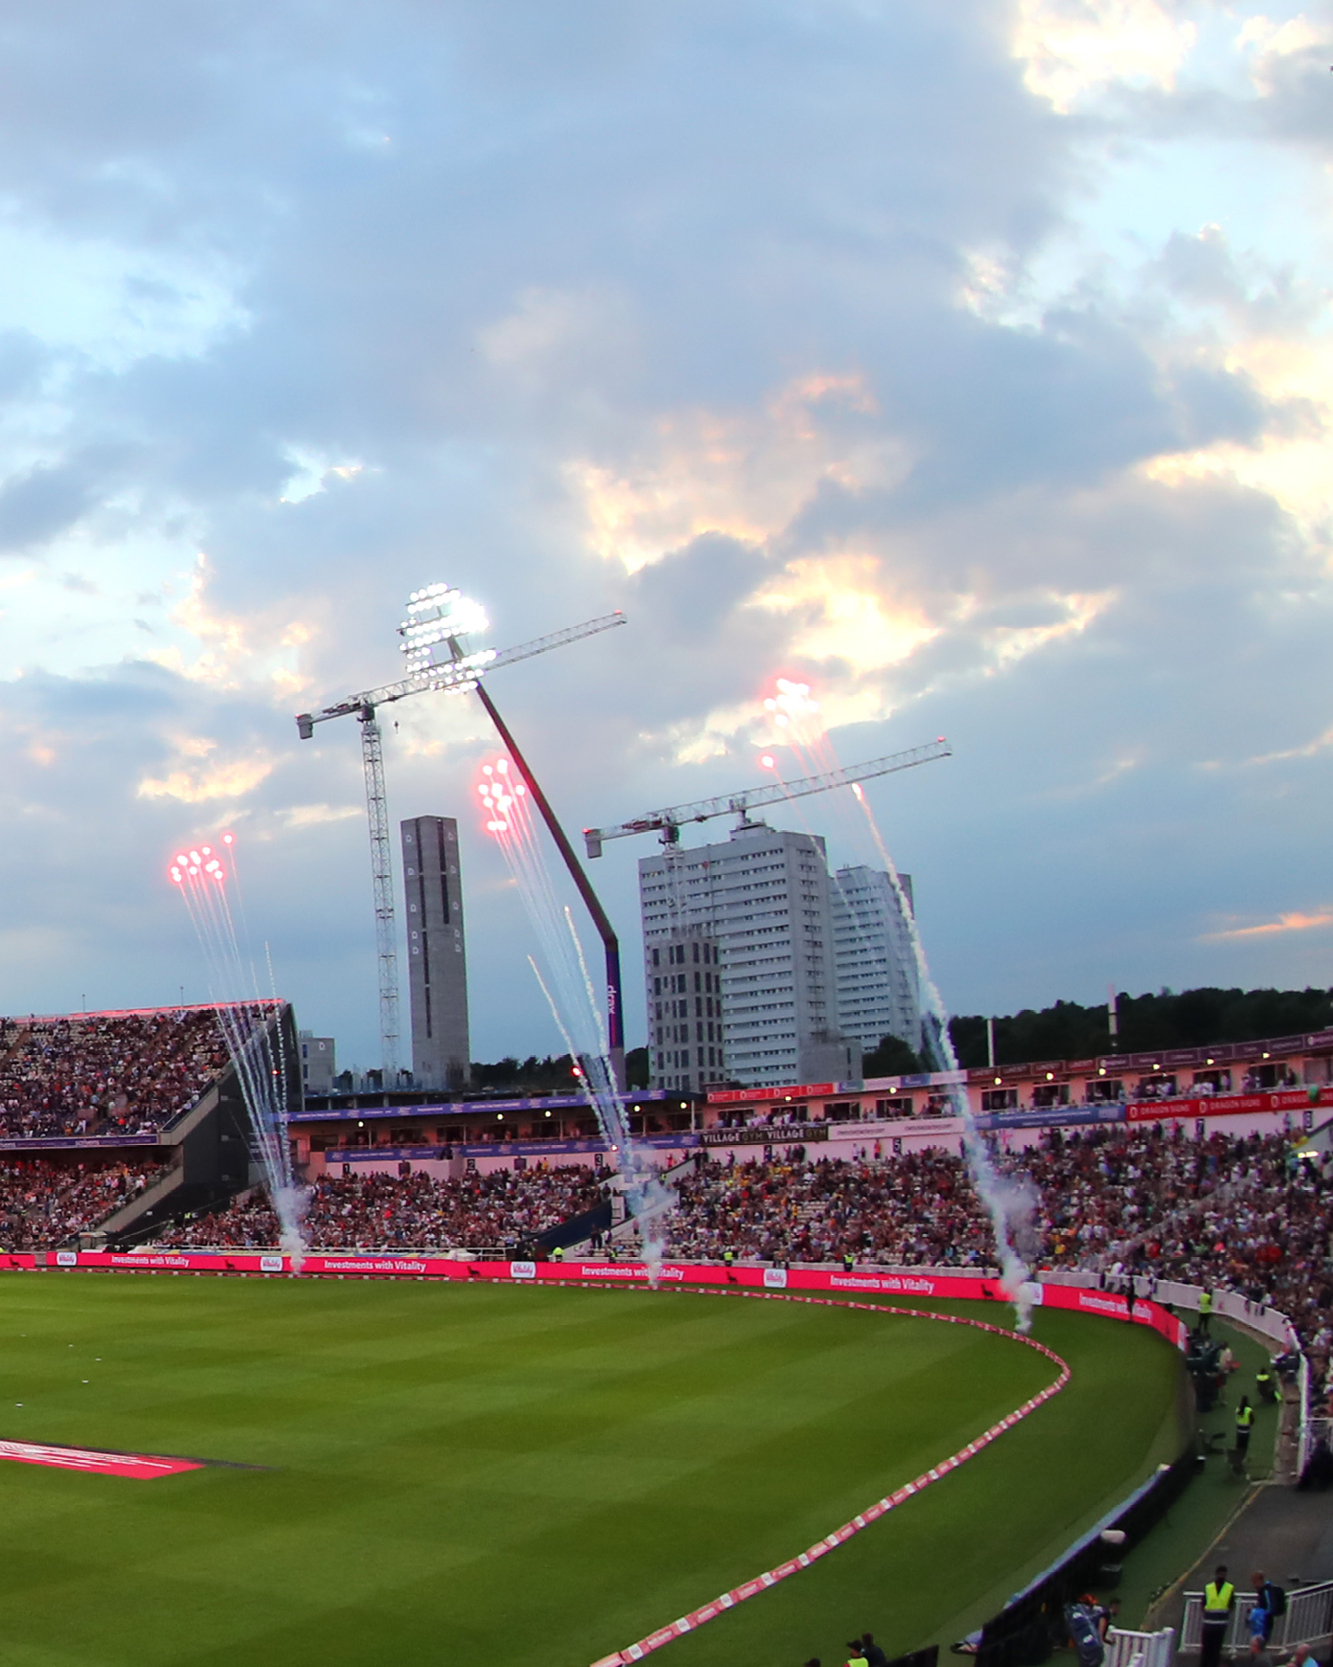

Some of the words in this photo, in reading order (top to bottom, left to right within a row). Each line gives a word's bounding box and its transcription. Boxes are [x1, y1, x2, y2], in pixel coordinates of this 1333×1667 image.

[702, 1133, 740, 1143] VILLAGE
[766, 1129, 804, 1139] VILLAGE
[111, 1256, 148, 1264] Investments
[149, 1256, 165, 1264] with
[165, 1257, 189, 1267] Vitality
[324, 1260, 373, 1270] Investments
[374, 1261, 393, 1270] with
[394, 1262, 427, 1272] Vitality
[582, 1266, 633, 1276] Investments
[831, 1275, 880, 1289] Investments
[881, 1277, 901, 1290] with
[903, 1279, 935, 1294] Vitality
